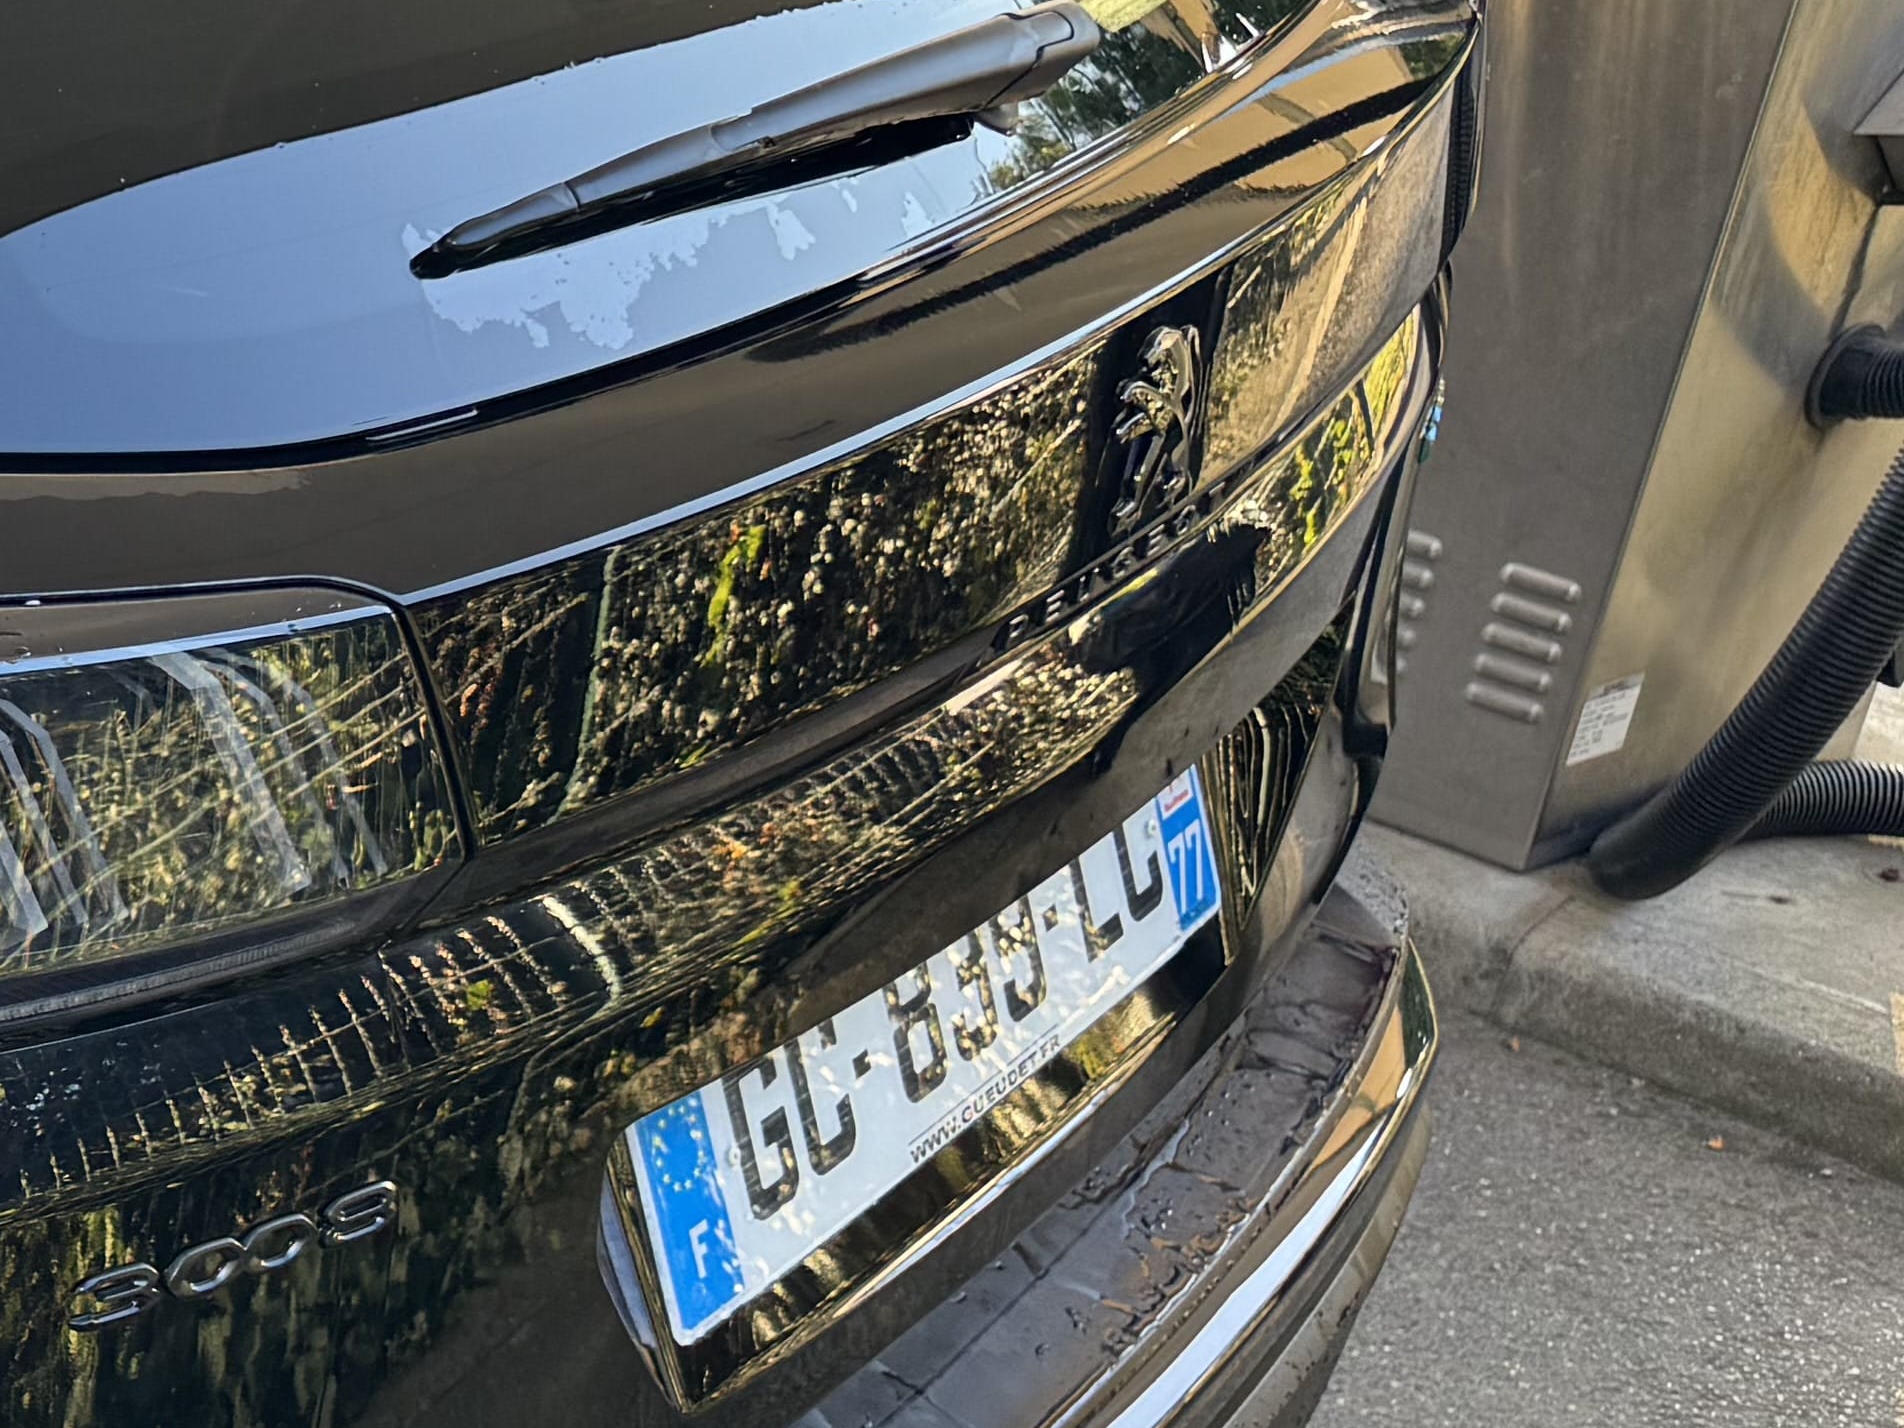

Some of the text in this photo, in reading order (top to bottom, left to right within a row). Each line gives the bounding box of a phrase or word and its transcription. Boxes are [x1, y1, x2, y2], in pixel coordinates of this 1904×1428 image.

[1168, 819, 1203, 915] 77
[910, 1033, 1061, 1164] WWW.GUEUDET.FR
[689, 1221, 708, 1278] F
